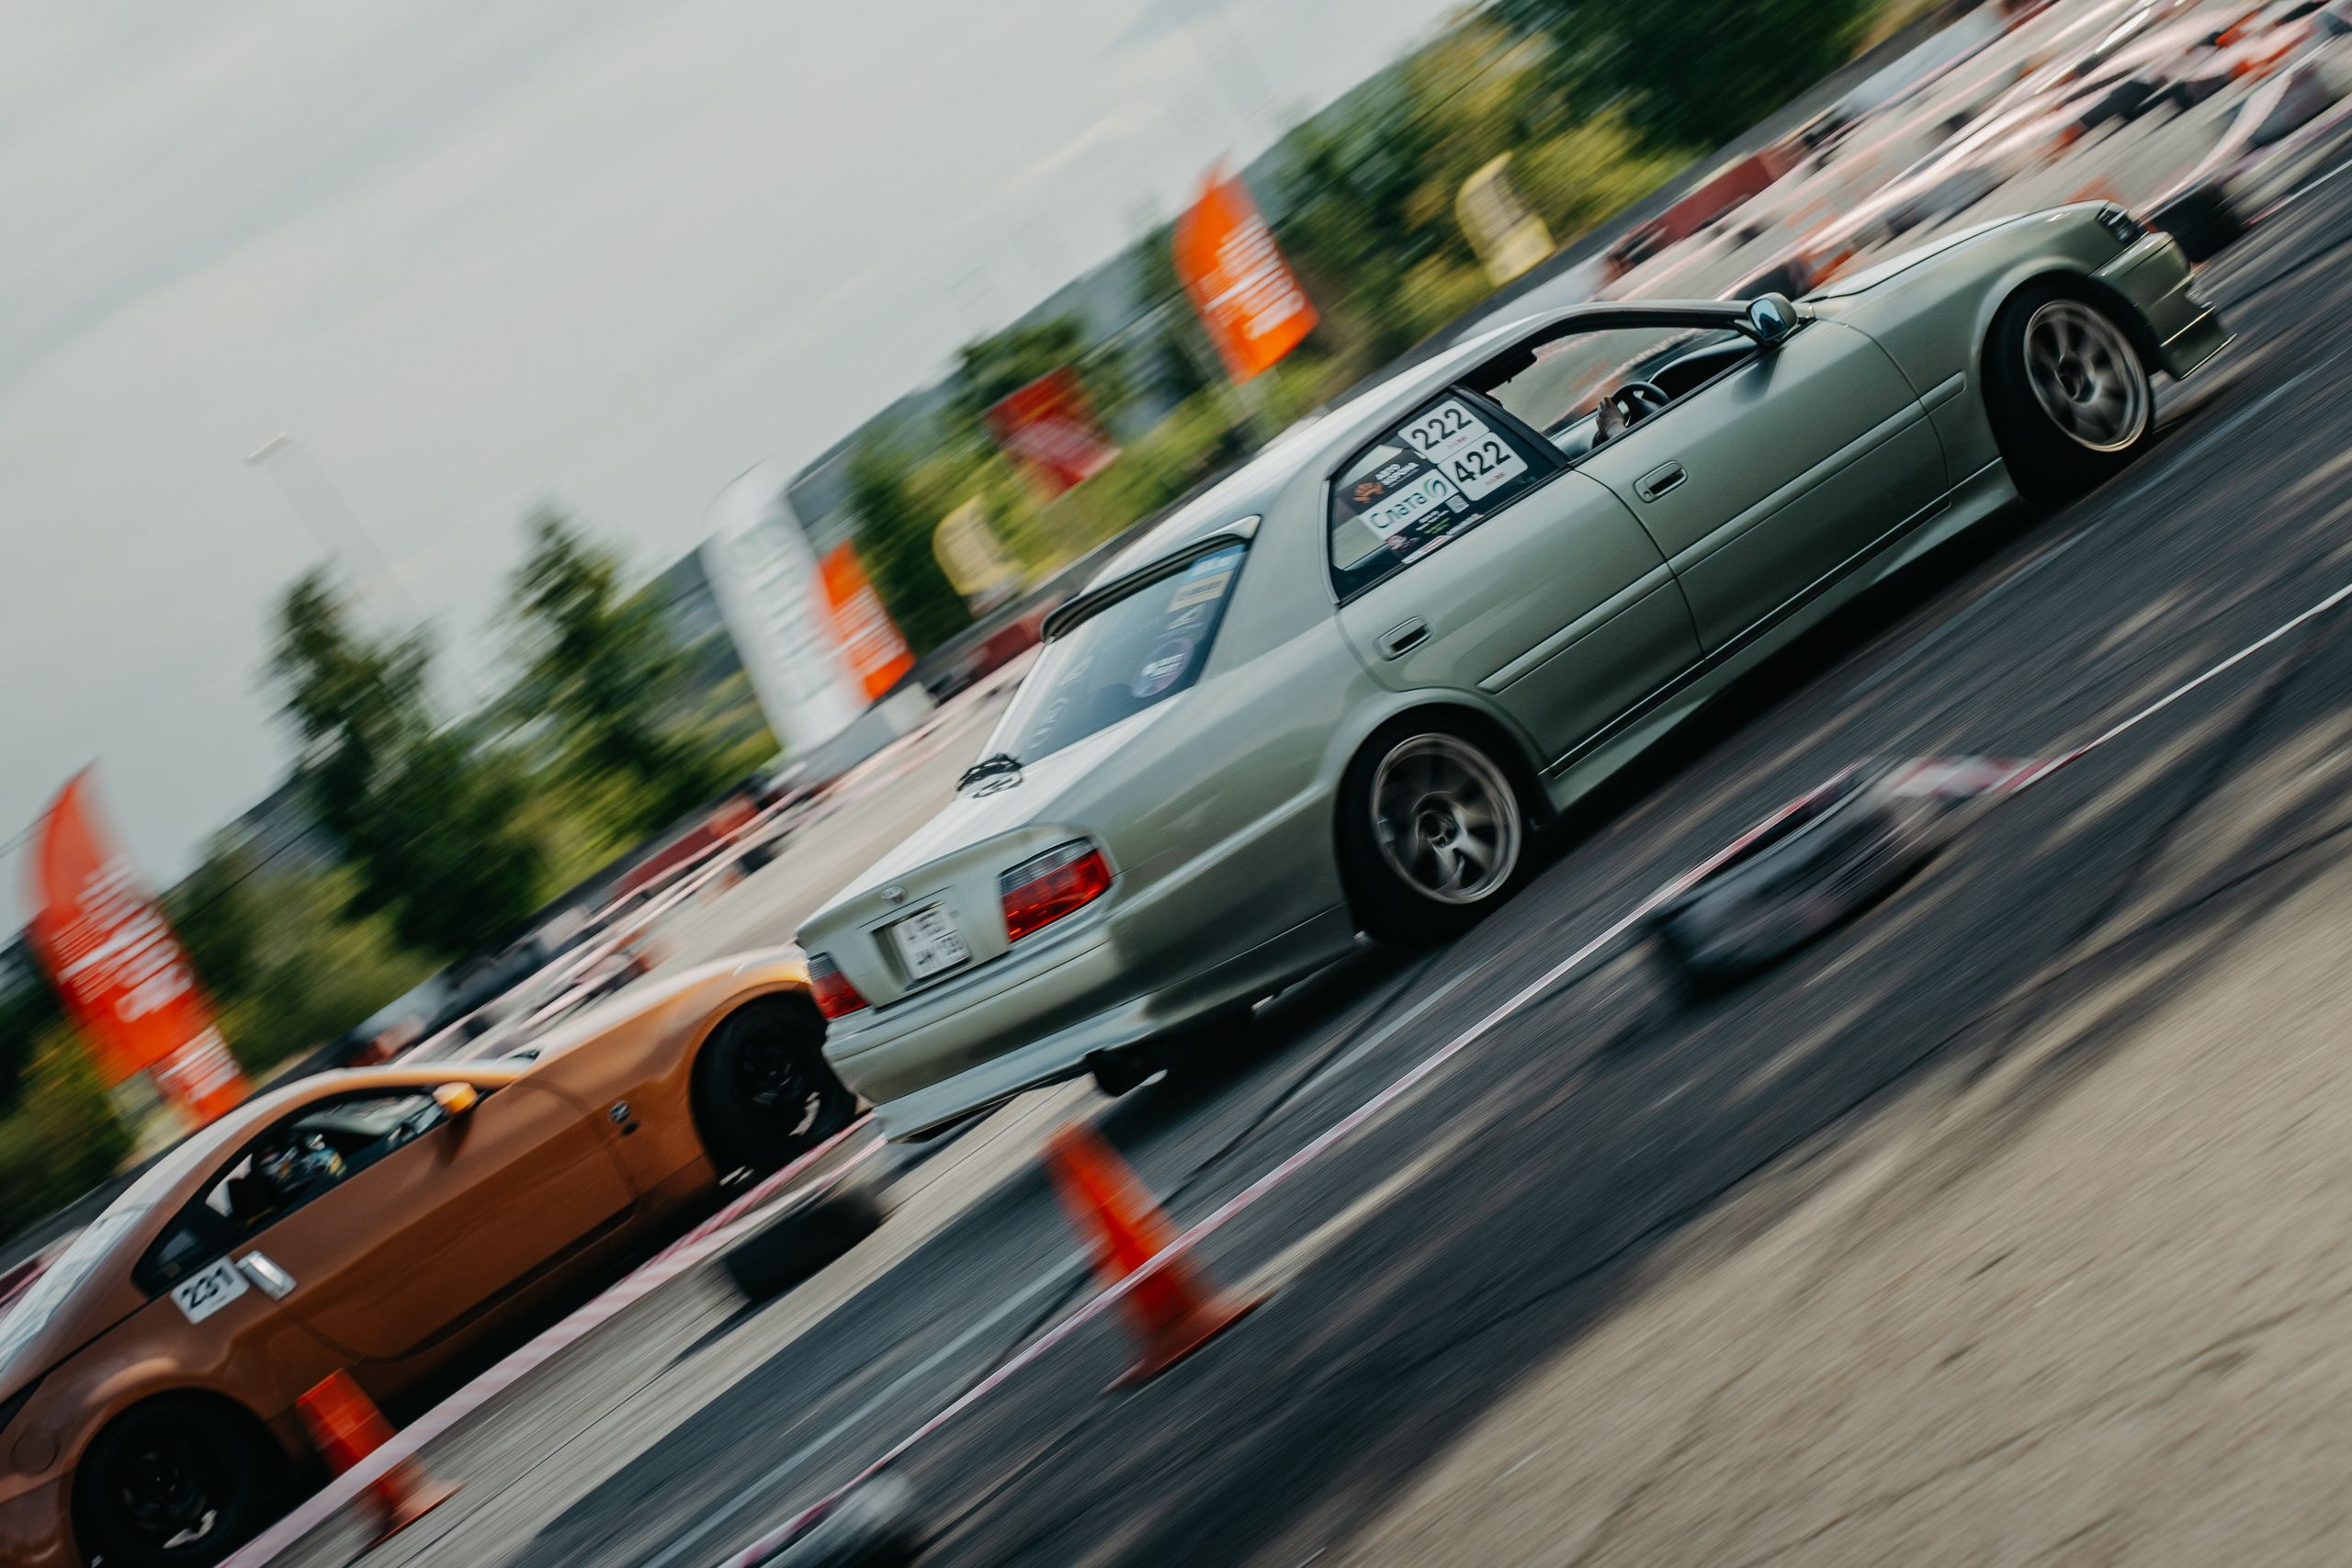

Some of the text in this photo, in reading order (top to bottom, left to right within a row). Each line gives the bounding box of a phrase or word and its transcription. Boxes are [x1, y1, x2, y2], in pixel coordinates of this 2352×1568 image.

[1411, 408, 1473, 450] 222
[1454, 441, 1511, 482] 422
[1370, 492, 1427, 529] Слата
[182, 1267, 233, 1309] 231
